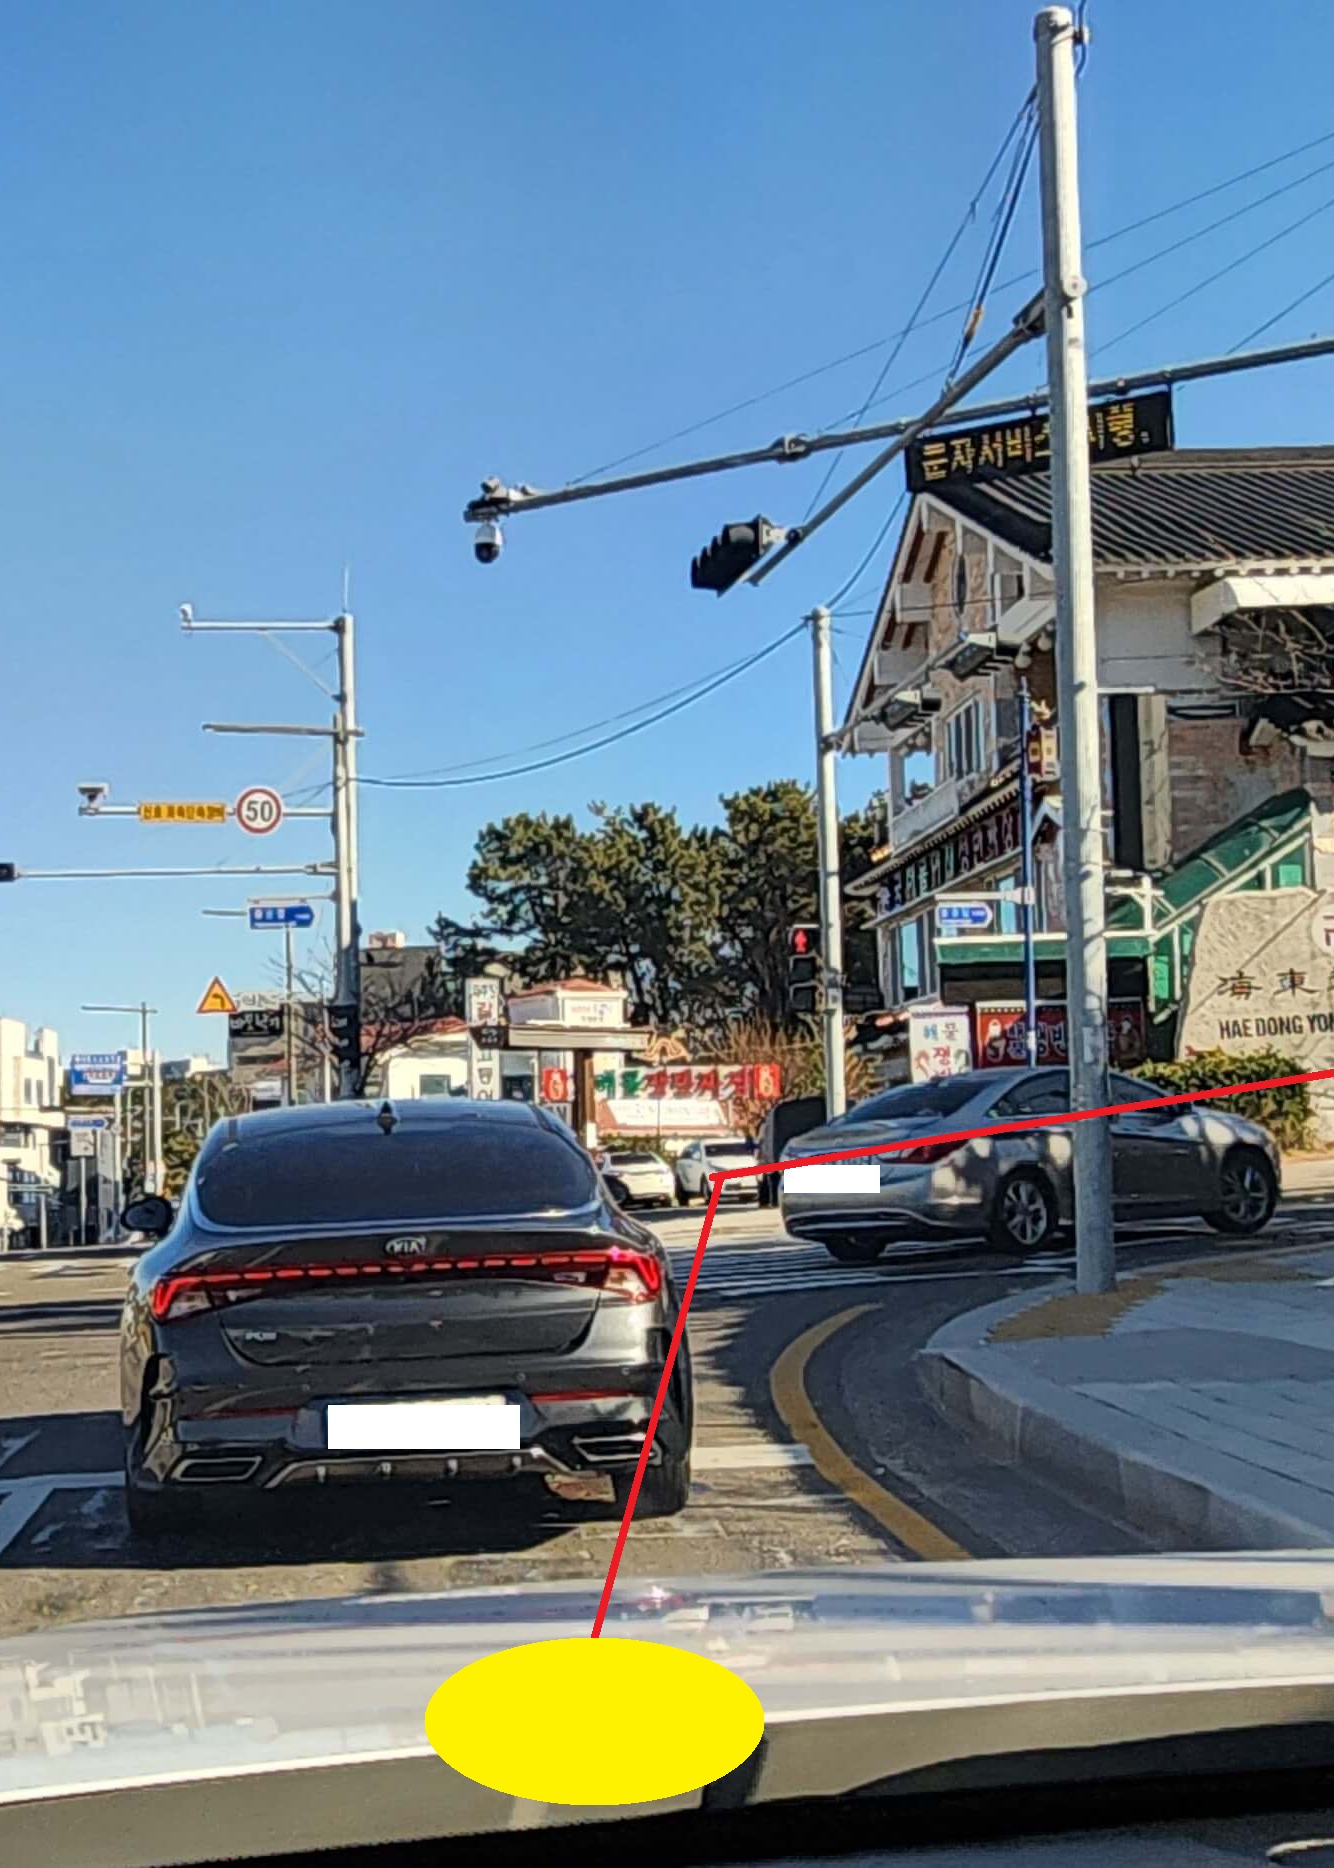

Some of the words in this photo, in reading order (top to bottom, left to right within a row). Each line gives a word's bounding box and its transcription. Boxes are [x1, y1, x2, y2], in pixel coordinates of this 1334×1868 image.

[245, 800, 273, 823] 50
[1219, 1018, 1254, 1040] HAE
[1255, 1014, 1304, 1037] DONG
[385, 1235, 427, 1255] KIA
